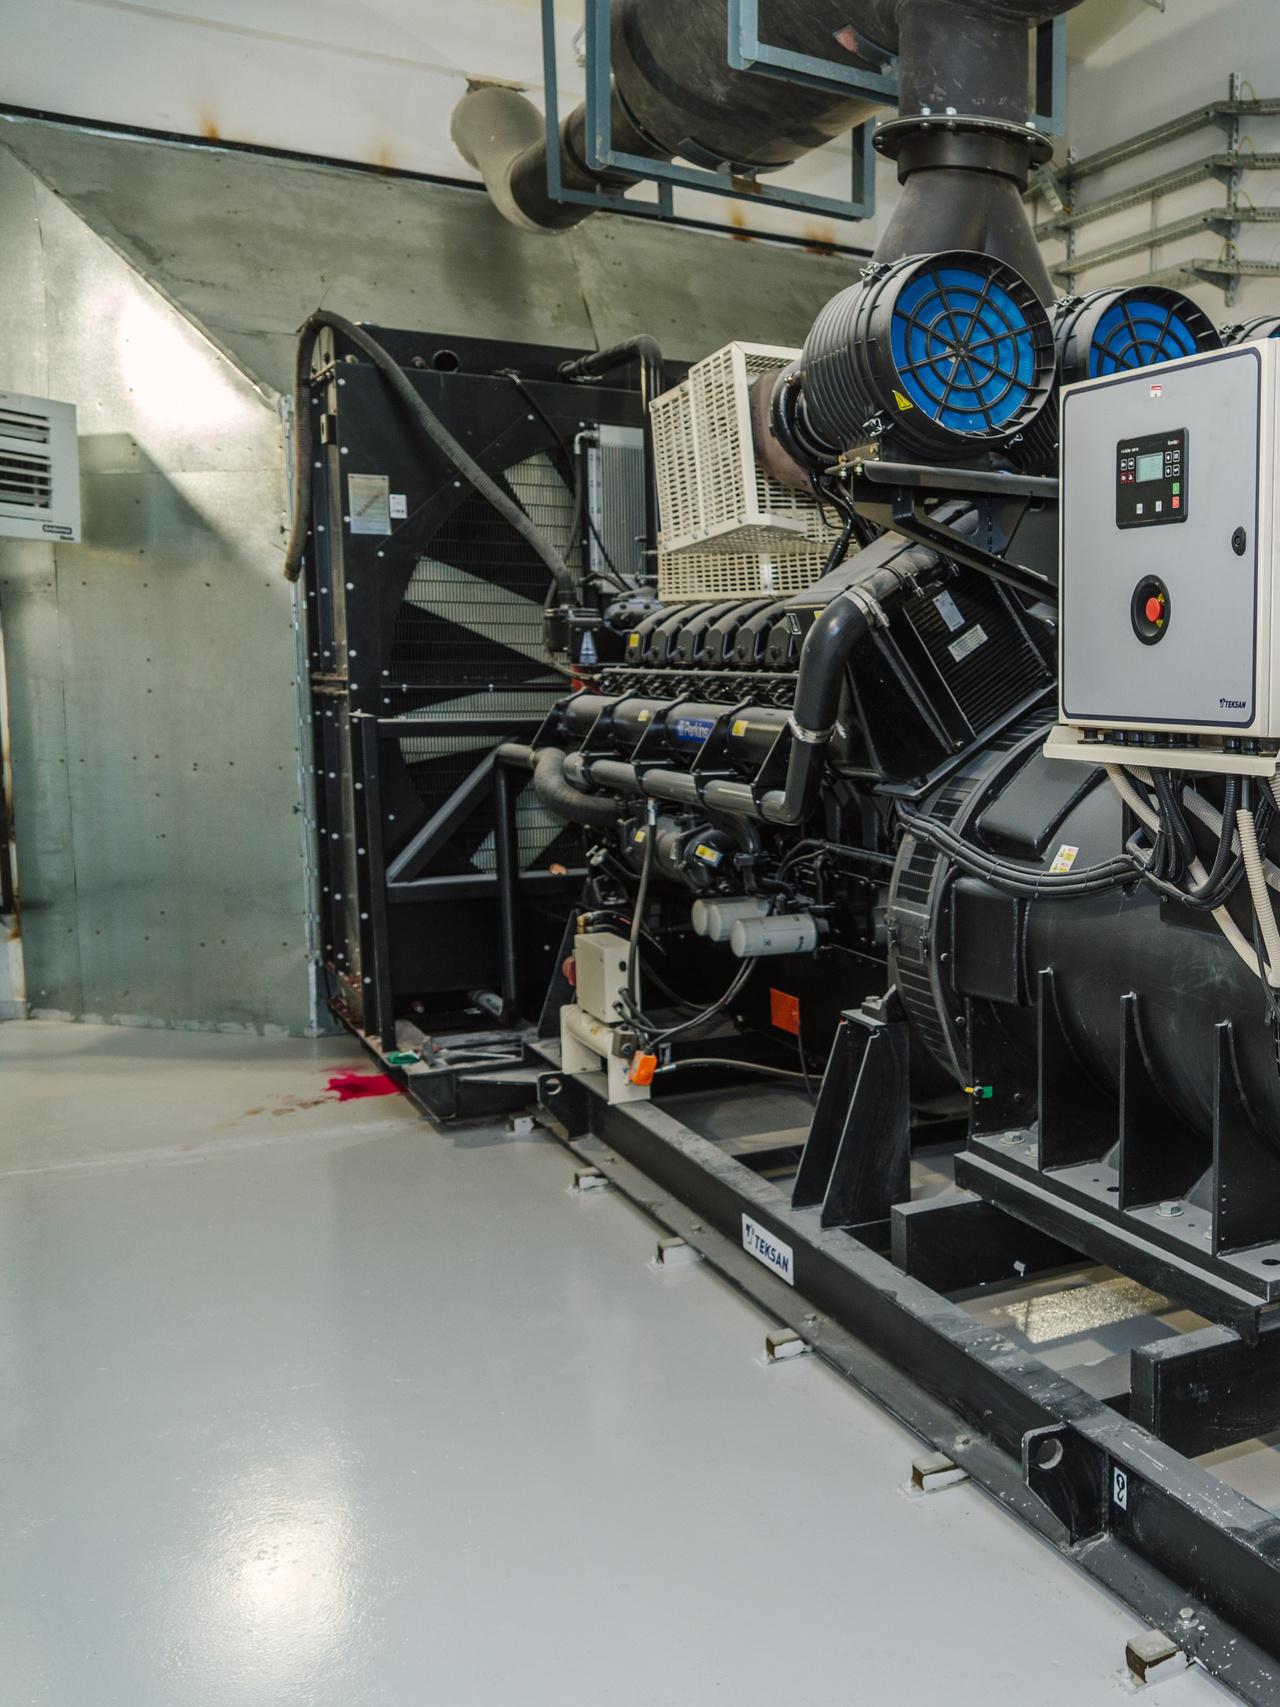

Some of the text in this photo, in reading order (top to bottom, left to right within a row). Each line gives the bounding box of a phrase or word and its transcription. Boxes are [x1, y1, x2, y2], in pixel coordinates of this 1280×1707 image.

[1225, 700, 1246, 709] TEKSAN
[684, 720, 709, 738] Perkins
[754, 1234, 789, 1273] TEKSAN
